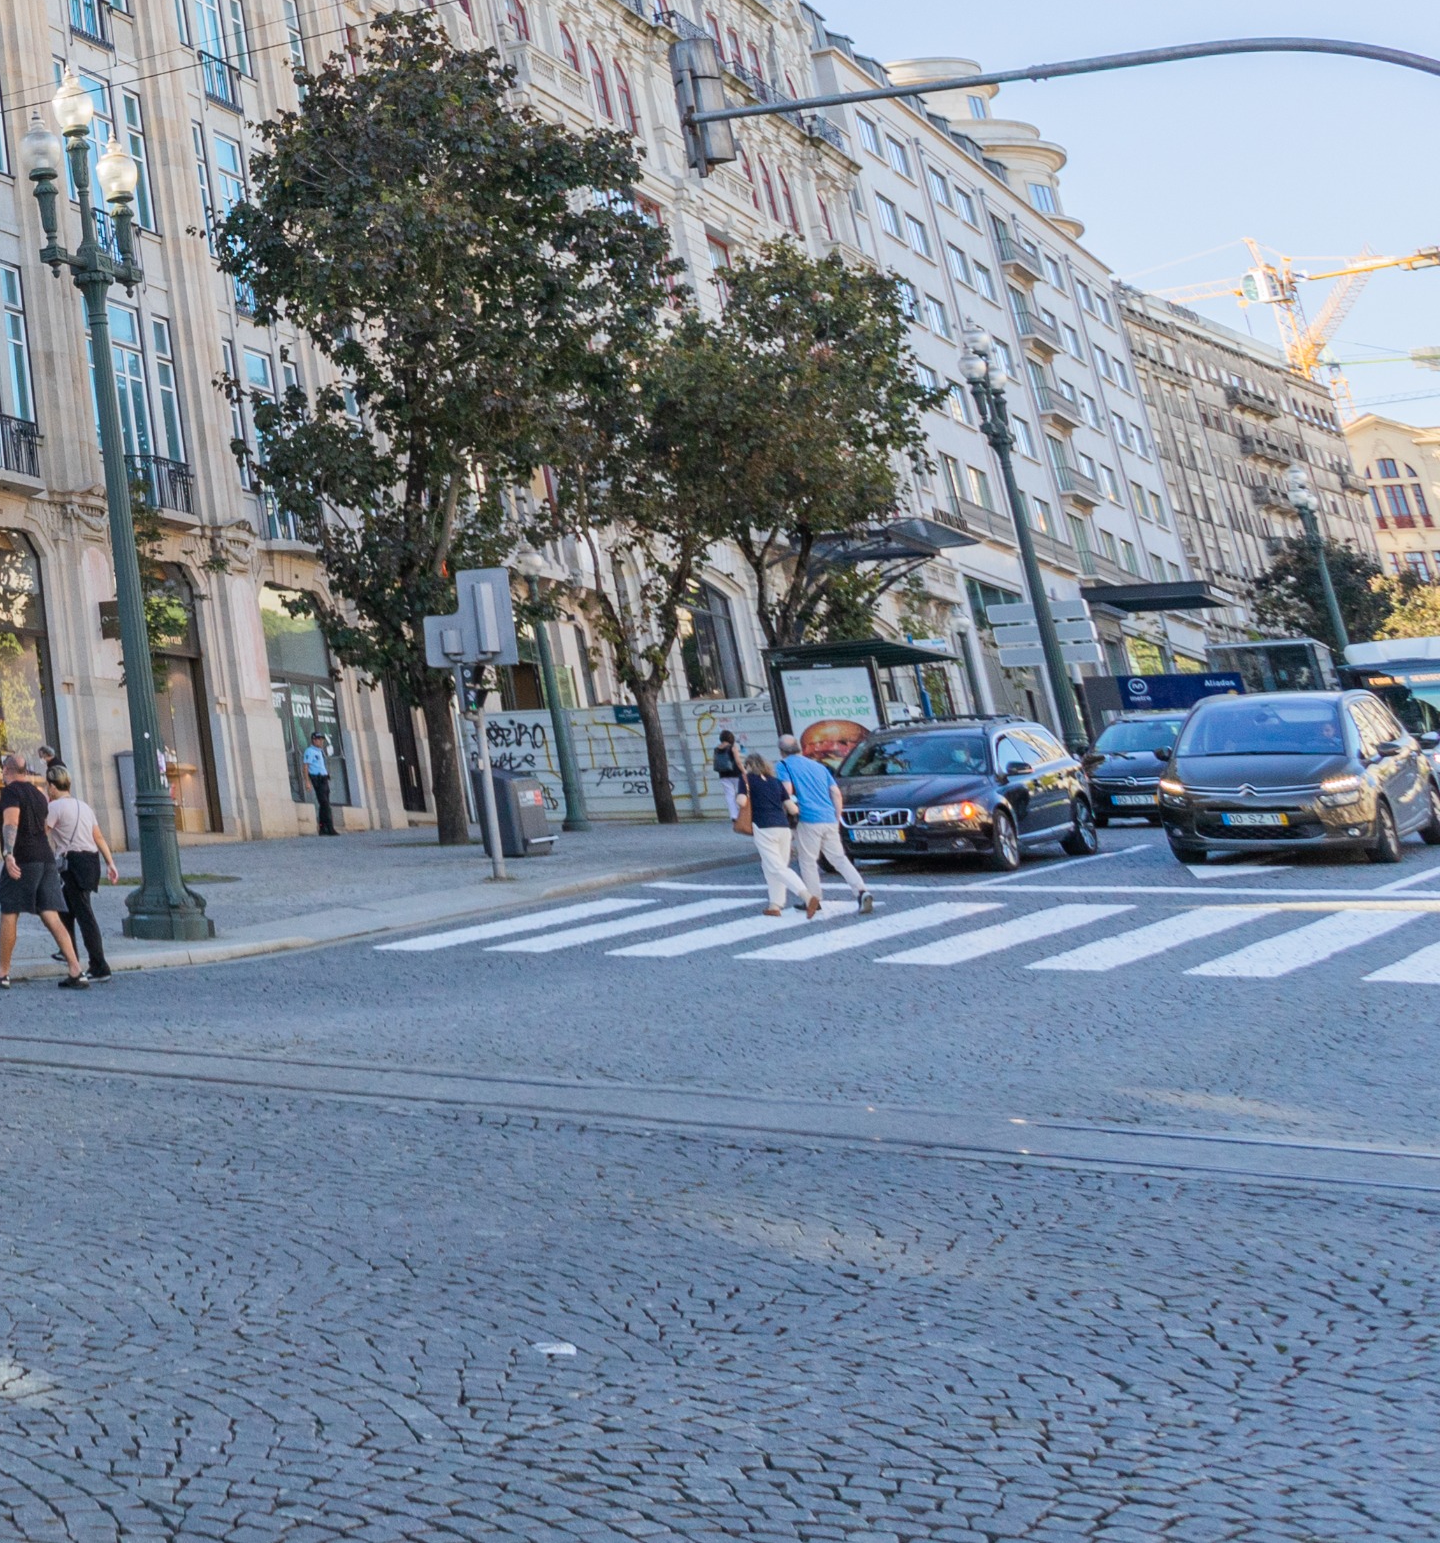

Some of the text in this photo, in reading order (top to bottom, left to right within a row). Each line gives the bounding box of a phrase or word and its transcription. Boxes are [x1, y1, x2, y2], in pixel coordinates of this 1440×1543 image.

[1204, 679, 1236, 688] Aliados
[814, 694, 869, 705] Bravo ao
[291, 702, 314, 720] LOJA
[792, 706, 872, 718] hamburguer
